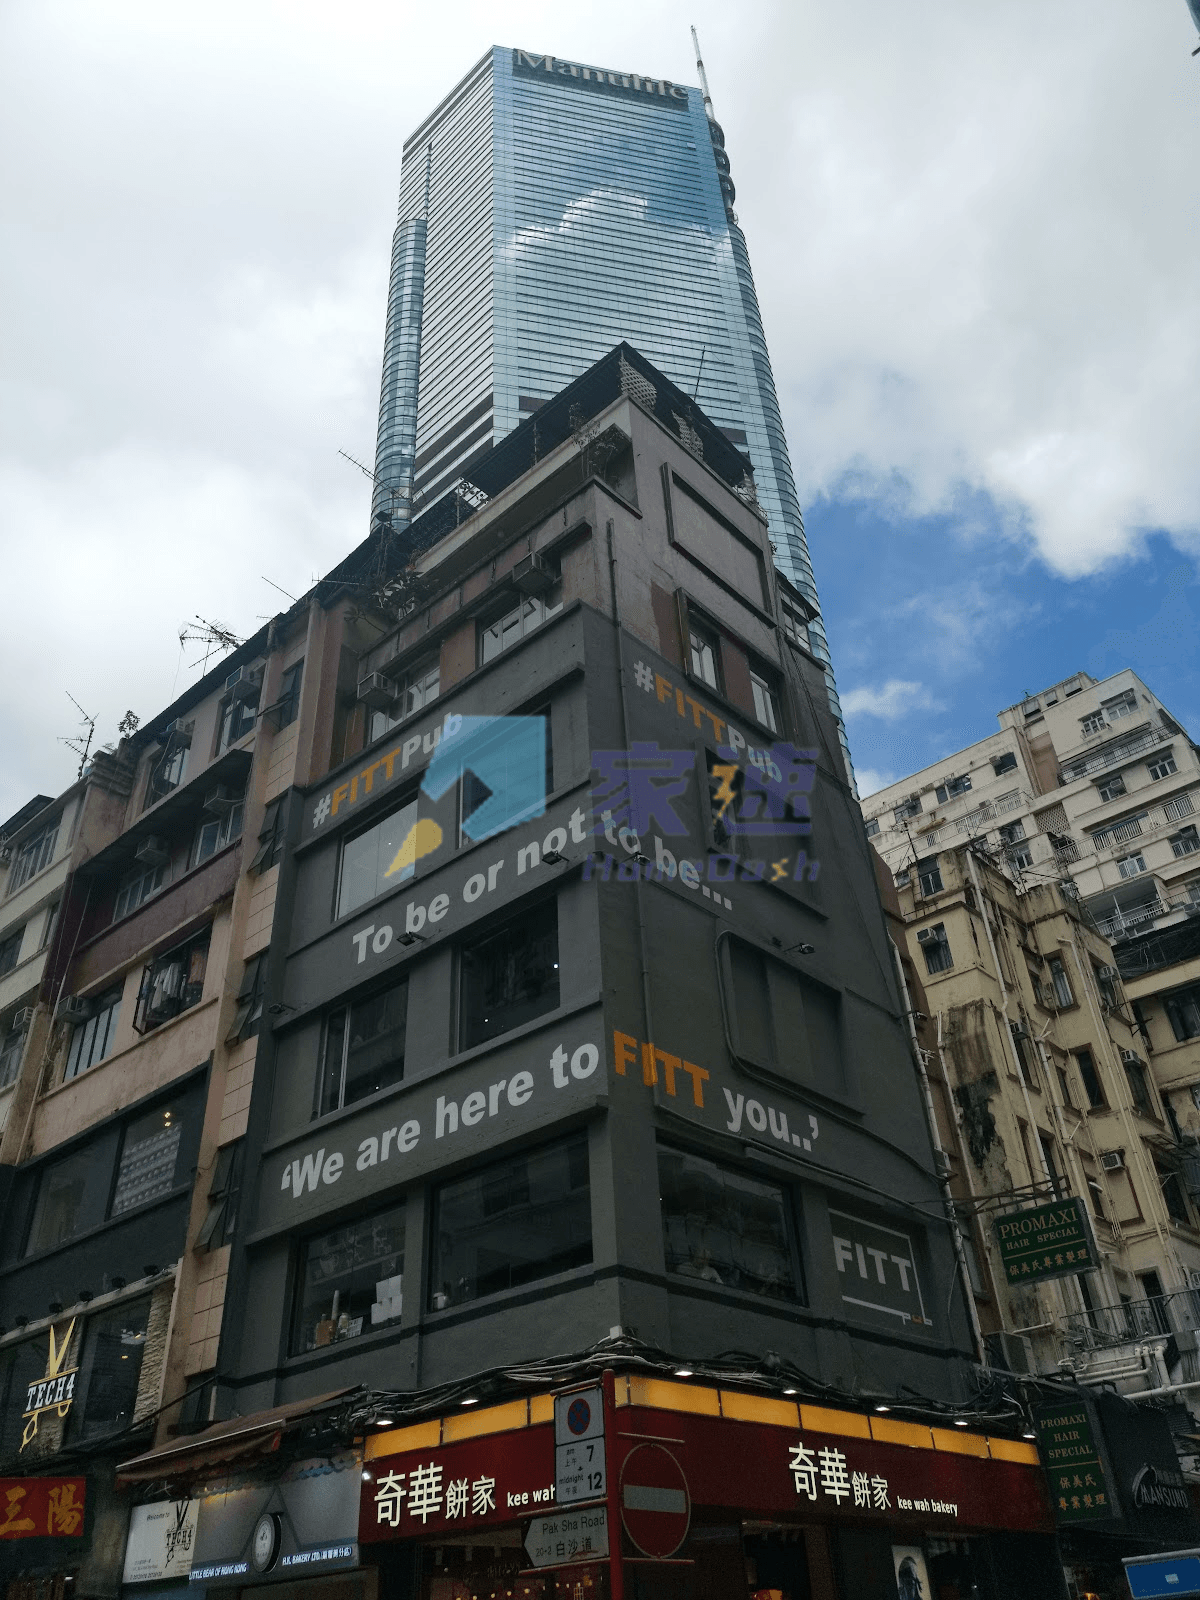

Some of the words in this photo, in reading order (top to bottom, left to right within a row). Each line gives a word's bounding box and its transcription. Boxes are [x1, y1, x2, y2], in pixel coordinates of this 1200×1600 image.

[517, 49, 689, 100] Manulife
[633, 660, 782, 784] #FITTPub
[312, 711, 463, 829] #FITTPub
[352, 923, 393, 965] To
[406, 891, 449, 936] be
[462, 860, 504, 903] or
[516, 808, 587, 877] not
[600, 809, 642, 855] to
[356, 1119, 420, 1172] are
[435, 1070, 534, 1139] here
[549, 1043, 599, 1089] to
[613, 1029, 710, 1108] FITT
[999, 1207, 1079, 1240] PROMAXI
[1006, 1238, 1030, 1251] HAIR
[1037, 1226, 1079, 1244] SPECIAL
[833, 1236, 912, 1292] FITT
[25, 1372, 76, 1413] TECH4
[1040, 1414, 1087, 1429] PROMAXI
[1054, 1430, 1081, 1443] HAIR
[587, 1445, 594, 1462] 7
[1048, 1445, 1093, 1459] SPECIAL
[558, 1474, 584, 1485] midnight
[587, 1471, 603, 1491] 12
[788, 1442, 892, 1511] 奇華餅家
[374, 1462, 496, 1527] 奇華餅家
[507, 1491, 529, 1508] kee
[897, 1495, 913, 1510] kee
[913, 1498, 931, 1512] wah
[931, 1499, 958, 1517] bakery
[542, 1522, 559, 1535] Pak
[561, 1519, 578, 1532] Sha
[580, 1514, 605, 1529] Road
[556, 1536, 592, 1557] 白沙道
[292, 1553, 311, 1564] BAKERY
[202, 1567, 215, 1578] BEAR
[214, 1566, 221, 1577] OF
[234, 1563, 247, 1575] KONG
